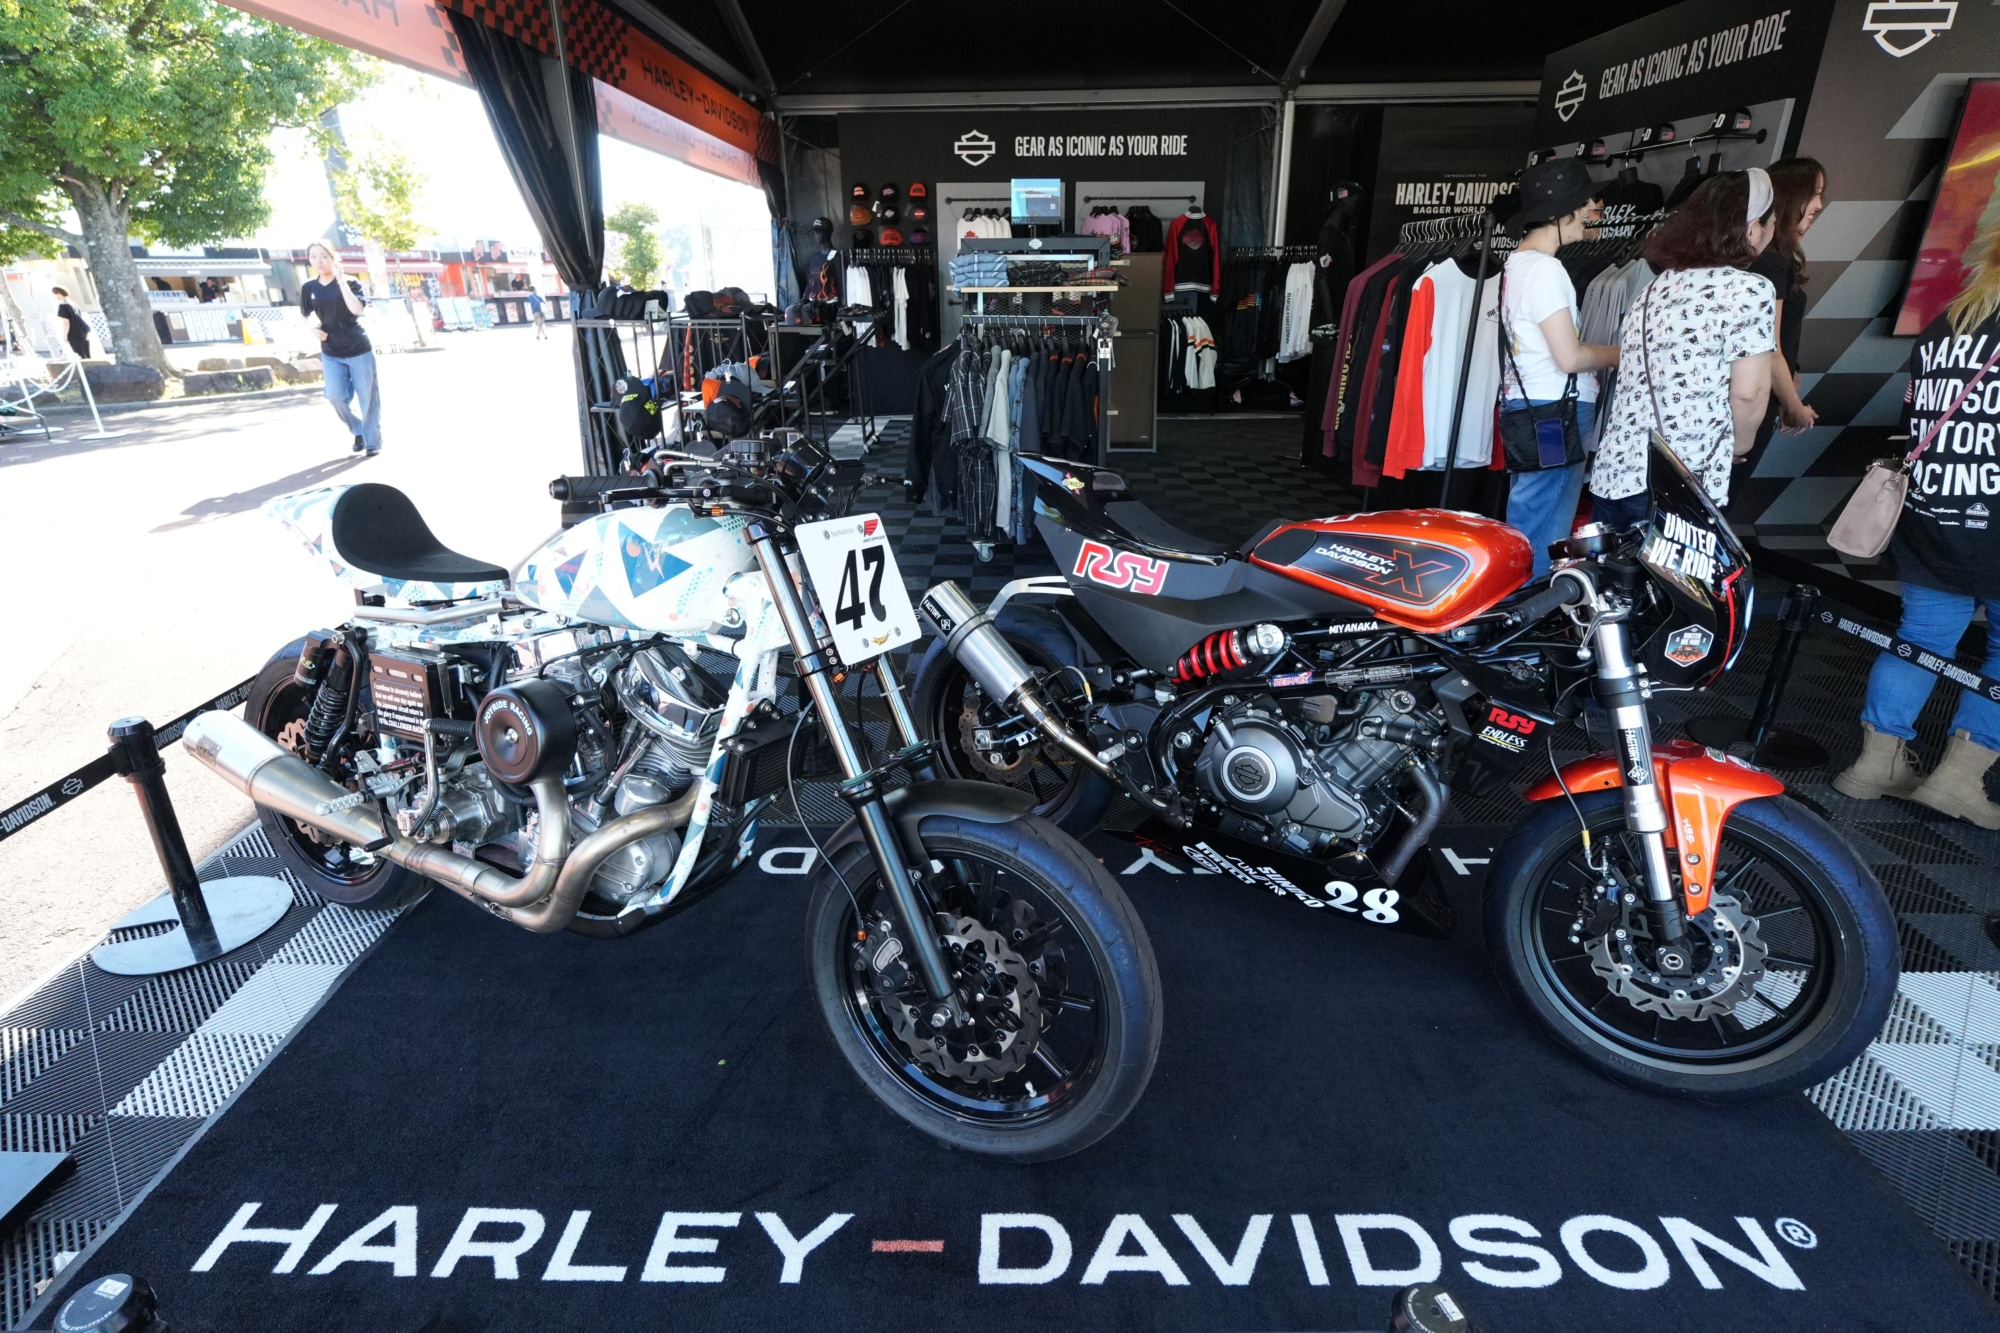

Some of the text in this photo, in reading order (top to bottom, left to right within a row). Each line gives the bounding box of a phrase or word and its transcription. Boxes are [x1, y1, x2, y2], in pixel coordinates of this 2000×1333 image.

[1600, 10, 1791, 100] GEAR AS ICONIC AS YOUR RIDE
[641, 55, 750, 136] HARLEY-DAVIDSON
[1014, 134, 1188, 157] GEAR AS ICONIC AS YOUR RIDE
[1412, 206, 1451, 214] BAGGER
[1664, 512, 1716, 557] UNITED
[1072, 538, 1170, 596] RSY
[1314, 546, 1392, 575] DAVIDSON
[1330, 543, 1396, 567] HARLEY-
[1648, 538, 1716, 584] WE RIDE
[834, 544, 887, 631] 47
[924, 599, 942, 620] FACTORY
[1328, 621, 1378, 635] MIYANAKA
[1838, 618, 1892, 650] HARLEY-DAVIDSON
[1273, 674, 1310, 687] RED FOX
[1626, 681, 1635, 690] 2
[1917, 652, 1982, 690] HARLEY-DAVIDSON
[484, 700, 533, 736] JOYRIDE RACING
[1482, 725, 1528, 748] ENDLESS
[1488, 707, 1536, 734] RSY
[1194, 841, 1256, 884] PIRELLI
[1225, 855, 1286, 896] SUNSTAR
[1257, 866, 1325, 908] SUNOCO
[1324, 880, 1400, 924] 28
[190, 1201, 855, 1285] HARLEY
